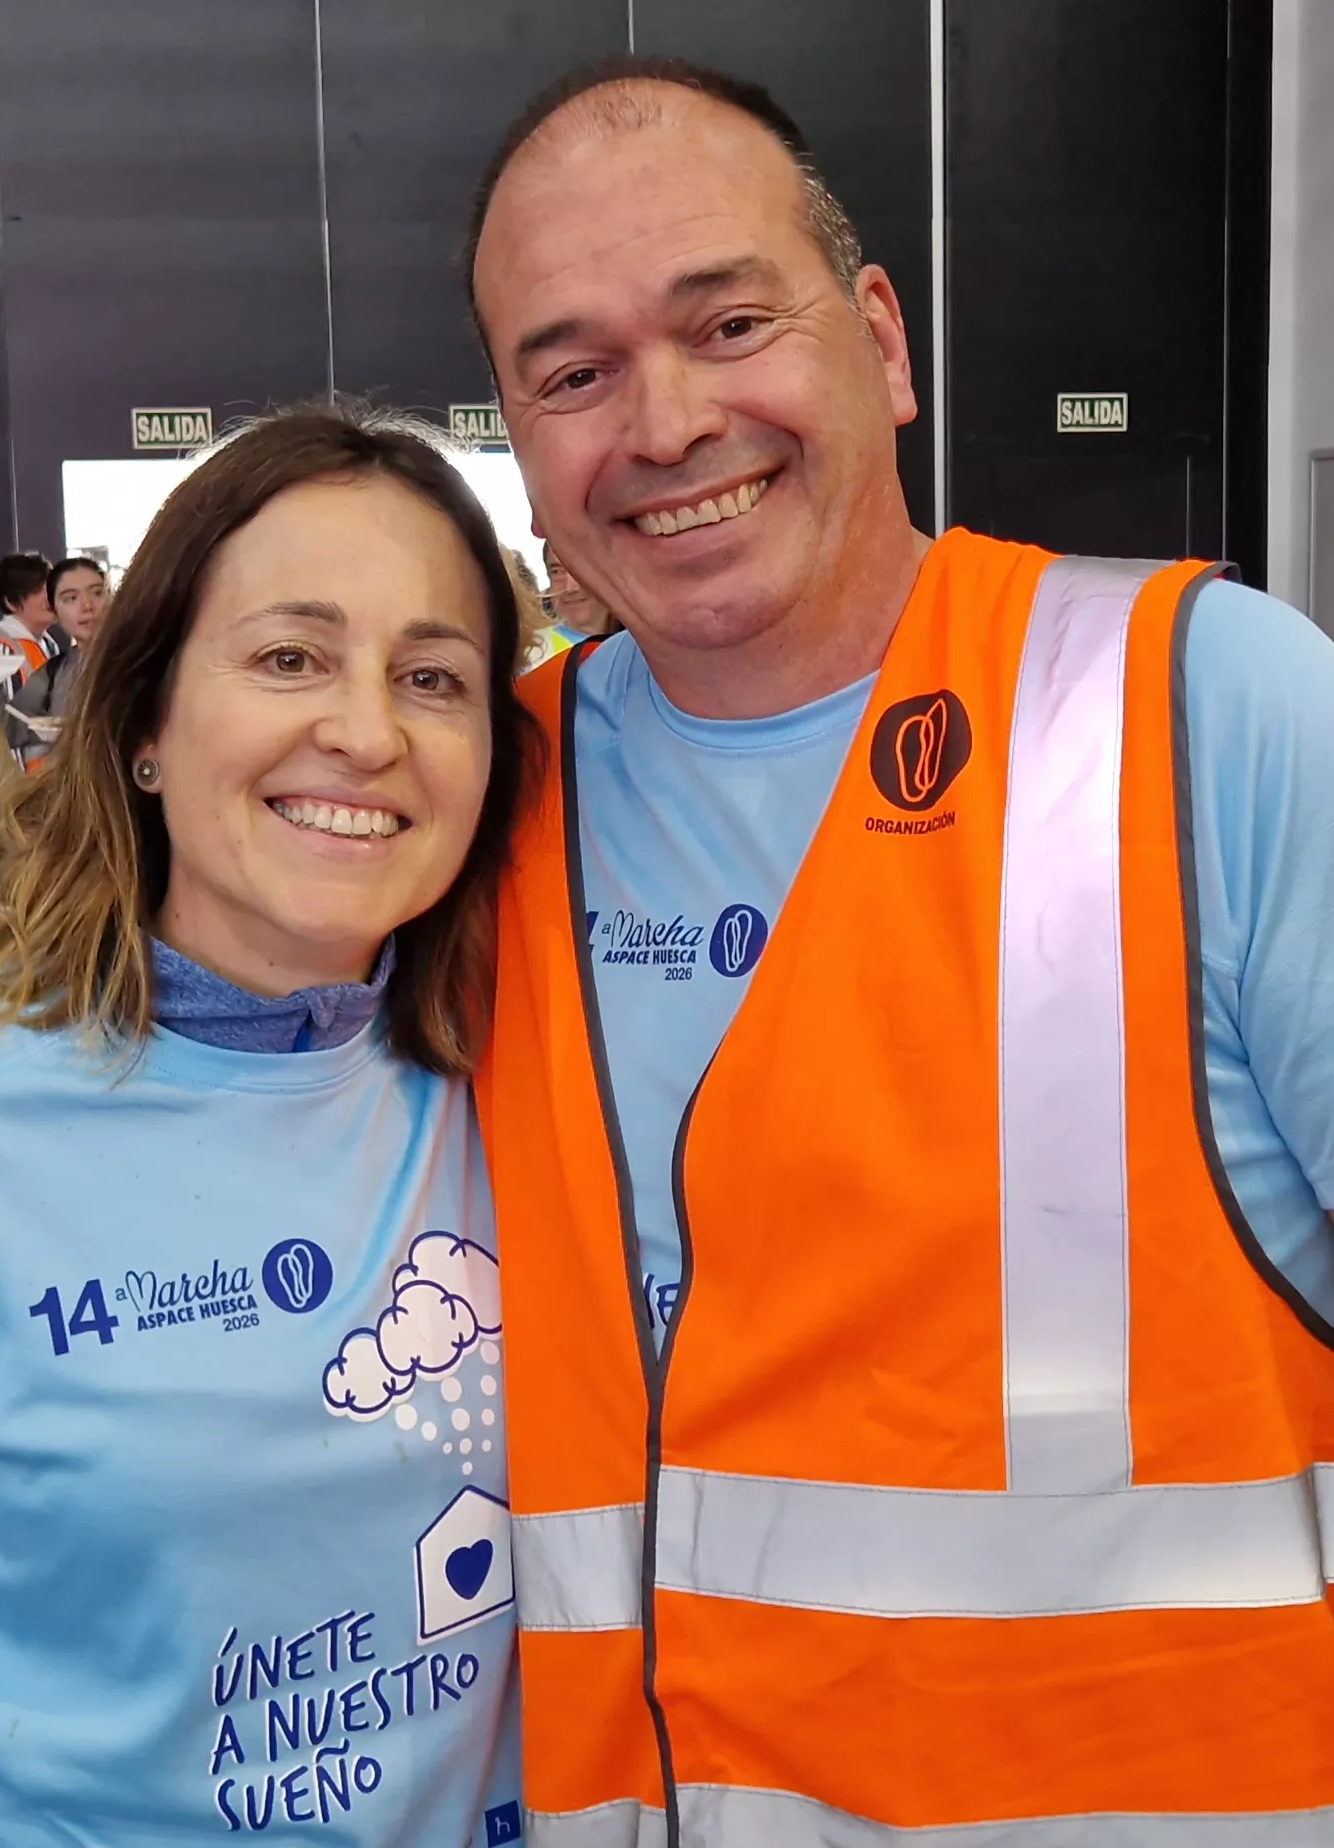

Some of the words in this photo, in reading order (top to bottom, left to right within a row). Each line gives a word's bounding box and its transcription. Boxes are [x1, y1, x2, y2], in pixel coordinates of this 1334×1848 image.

[454, 411, 508, 438] SALID
[1061, 400, 1123, 425] SALIDA
[137, 415, 208, 442] SALIDA
[865, 811, 956, 835] ORGANIZACIÓN
[611, 909, 705, 948] Marcha
[602, 950, 649, 965] ASPACE
[653, 949, 697, 964] HUESCA
[664, 967, 693, 981] 2026
[125, 1259, 254, 1313] Marcha
[137, 1306, 196, 1332] ASPACE
[199, 1294, 258, 1319] HUESCA
[223, 1313, 260, 1332] 2026
[213, 1610, 375, 1707] ÚNETE
[210, 1714, 245, 1775] A
[266, 1653, 479, 1762] NUESTRO
[216, 1738, 383, 1832] SUEÑO
